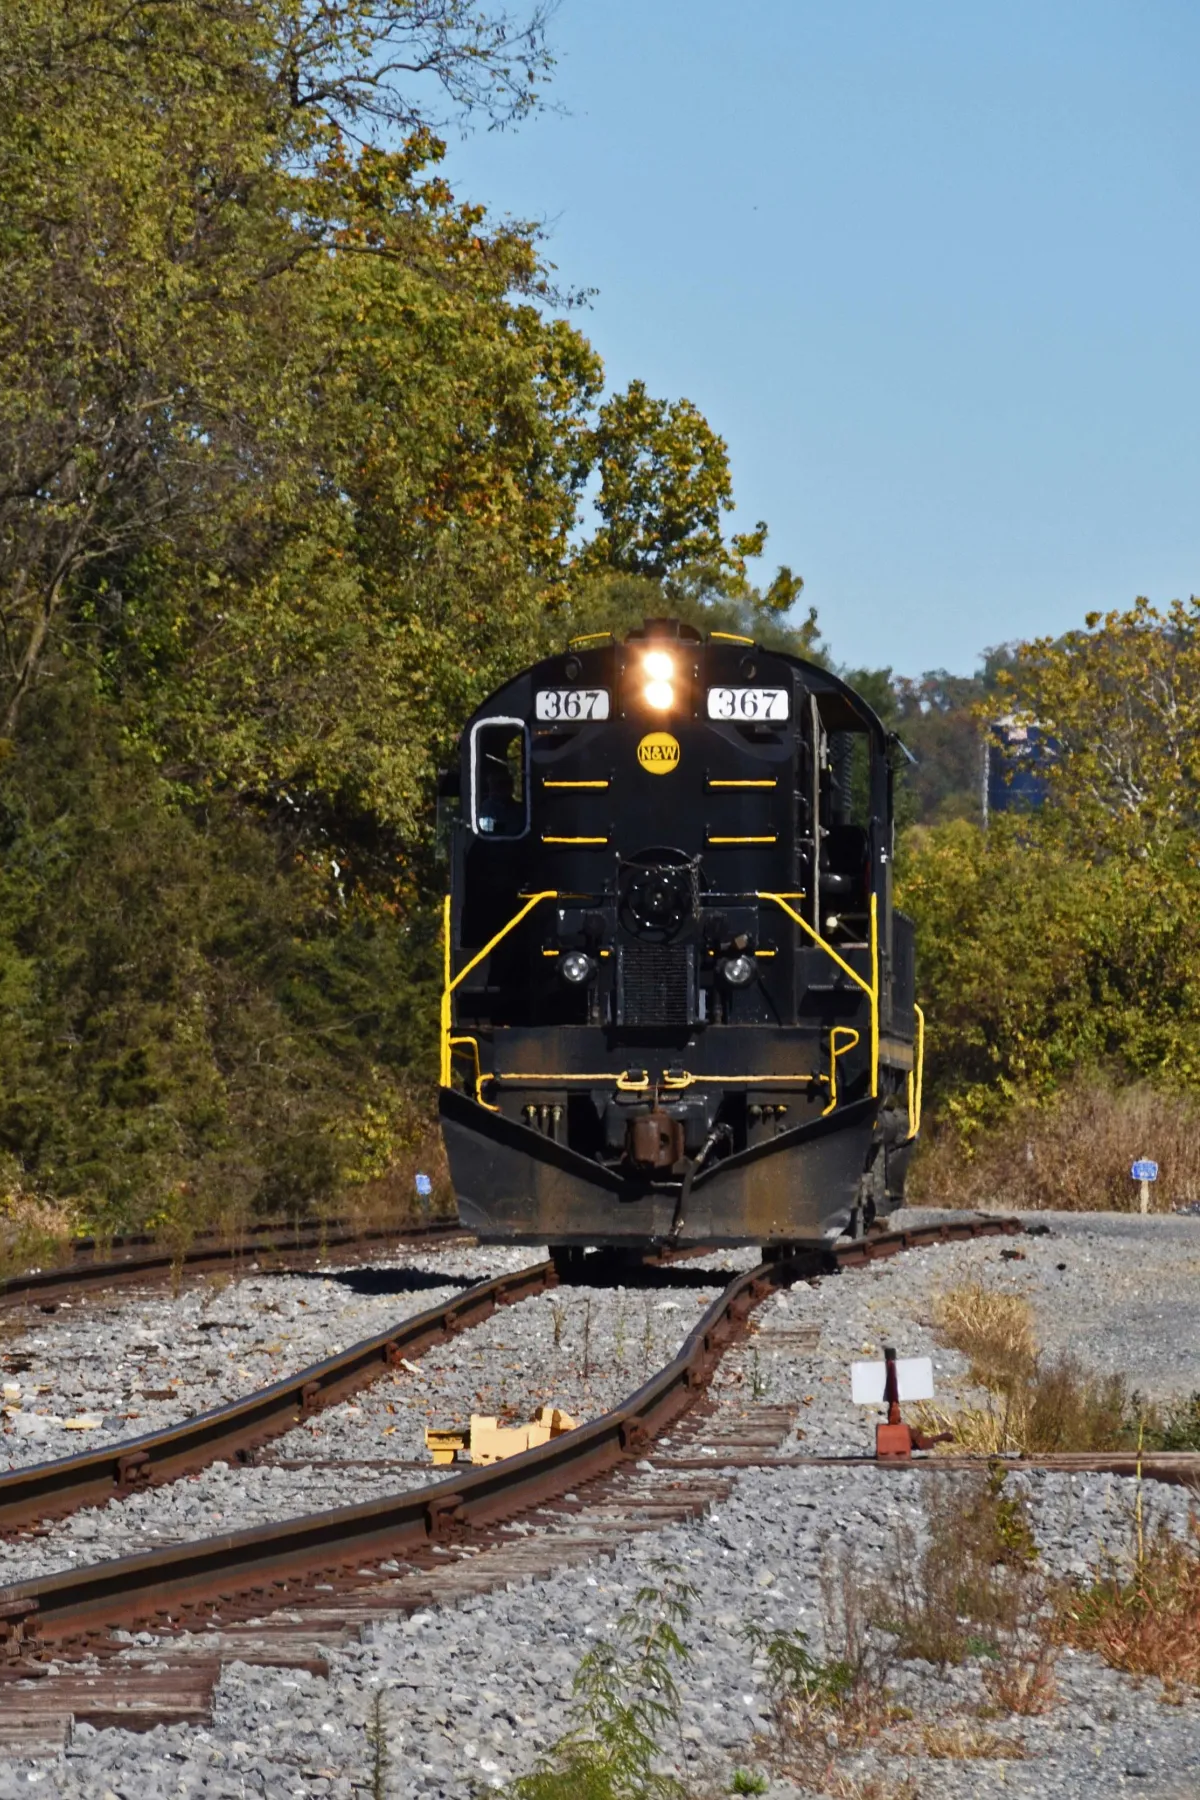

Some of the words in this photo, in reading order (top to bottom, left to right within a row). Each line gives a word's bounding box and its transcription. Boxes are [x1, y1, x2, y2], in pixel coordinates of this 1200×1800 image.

[544, 690, 601, 720] 367
[718, 689, 779, 720] 367
[641, 745, 677, 761] N&W
